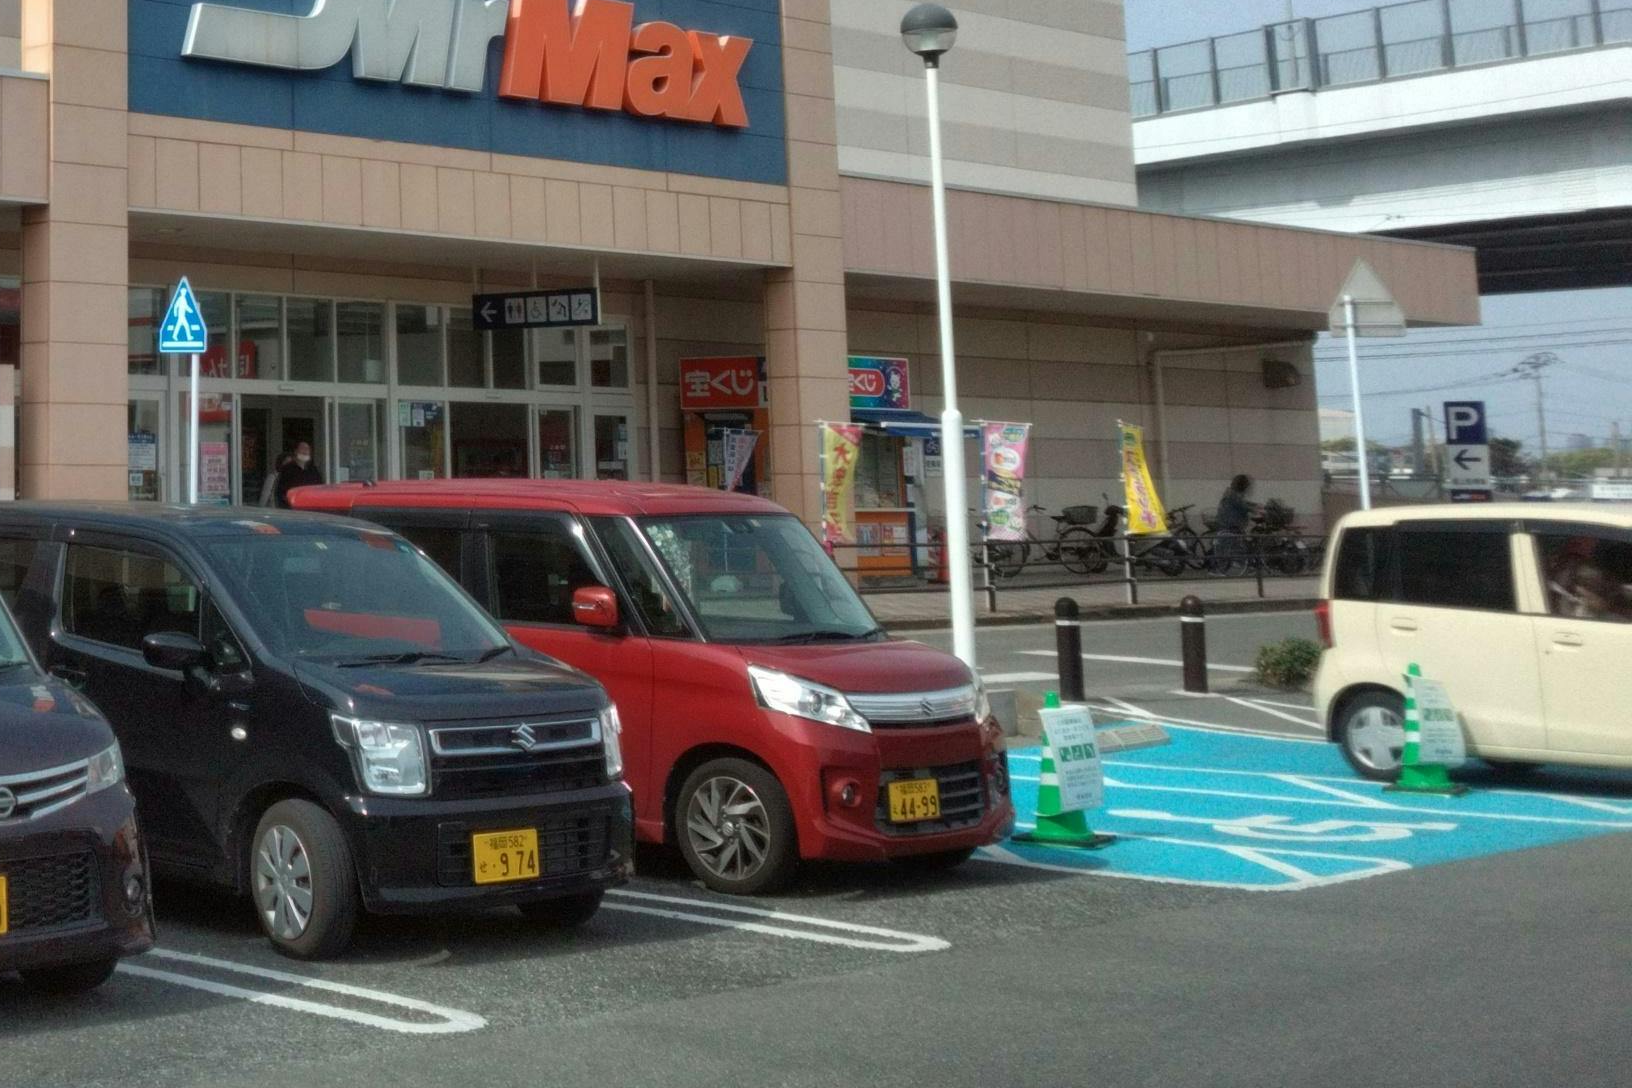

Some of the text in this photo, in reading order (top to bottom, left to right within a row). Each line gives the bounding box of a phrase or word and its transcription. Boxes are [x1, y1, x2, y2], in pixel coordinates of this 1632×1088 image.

[685, 369, 754, 397] 宝くじ
[1447, 406, 1479, 440] P
